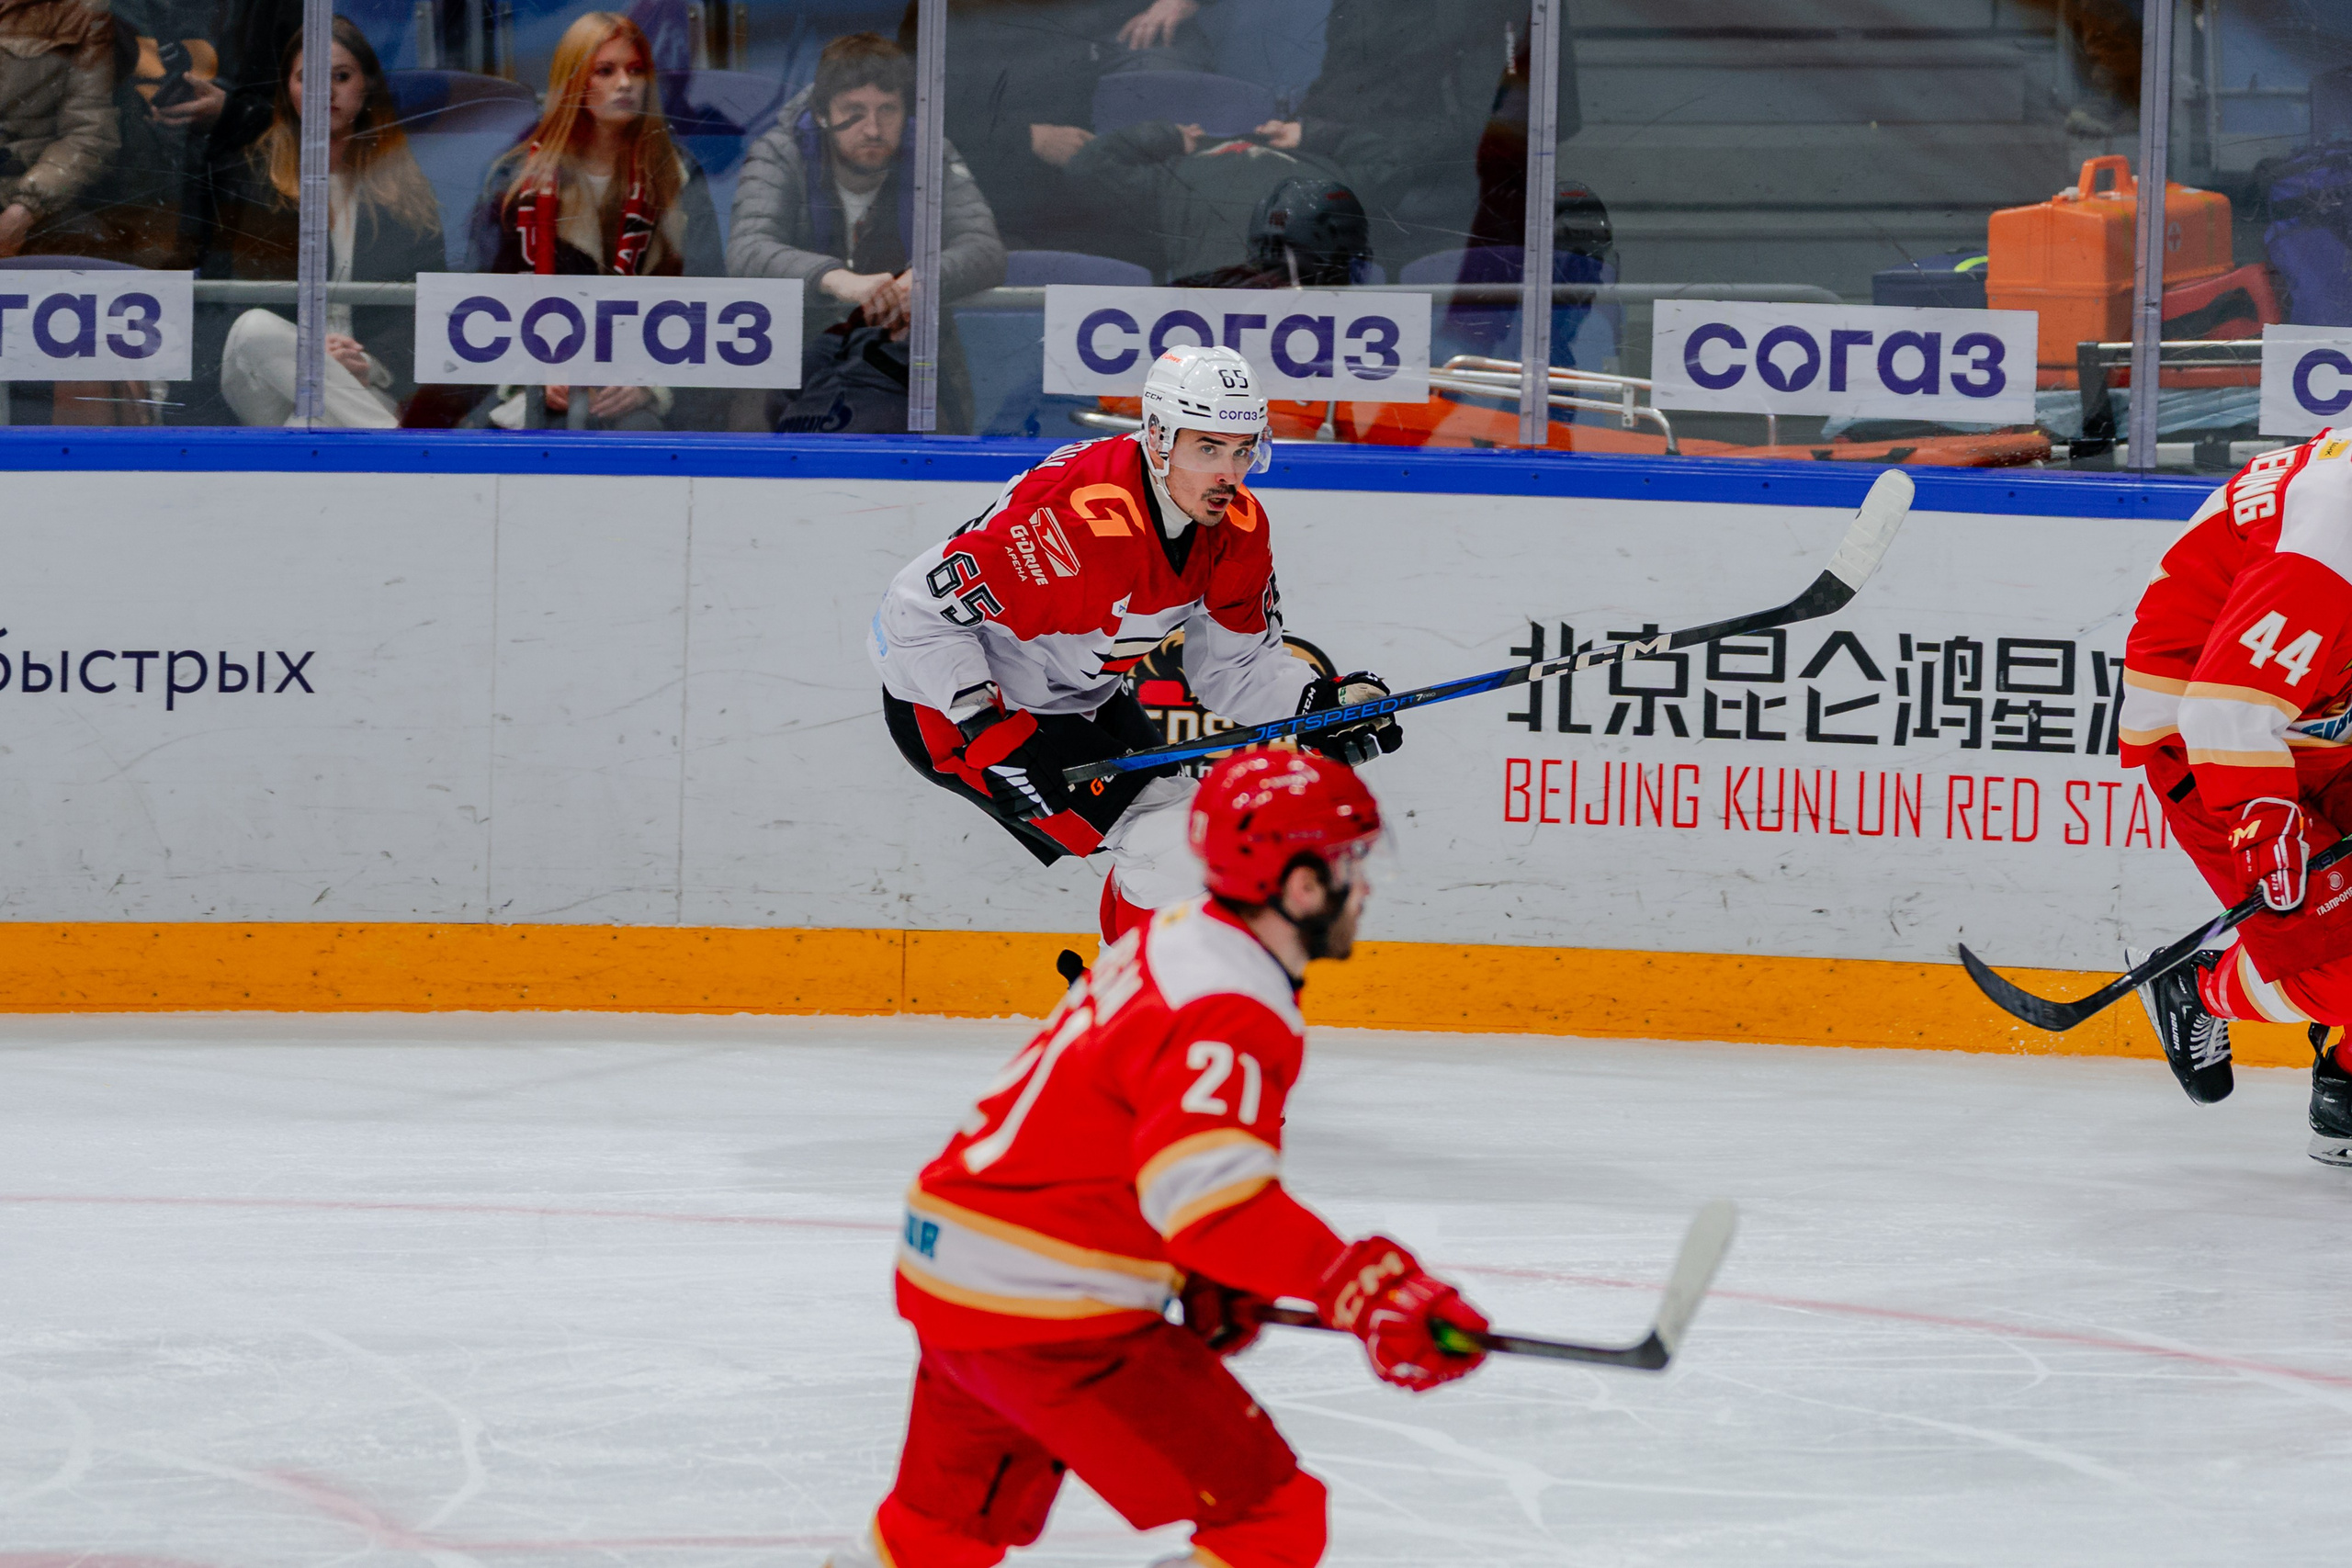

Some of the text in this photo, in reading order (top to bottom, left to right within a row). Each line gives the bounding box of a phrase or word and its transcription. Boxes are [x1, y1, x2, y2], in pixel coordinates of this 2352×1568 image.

[1144, 391, 1163, 402] CCM
[1218, 369, 1250, 389] 65
[926, 550, 1006, 627] 65
[0, 627, 316, 711] ыстрых
[1528, 632, 1673, 682] CCM
[2238, 609, 2324, 688] 44
[1248, 695, 1399, 743] JETSPEED
[1504, 757, 2170, 850] BEIJING KUNLUN RED STA
[2169, 1010, 2181, 1051] BAUER
[1180, 1039, 1263, 1126] 21
